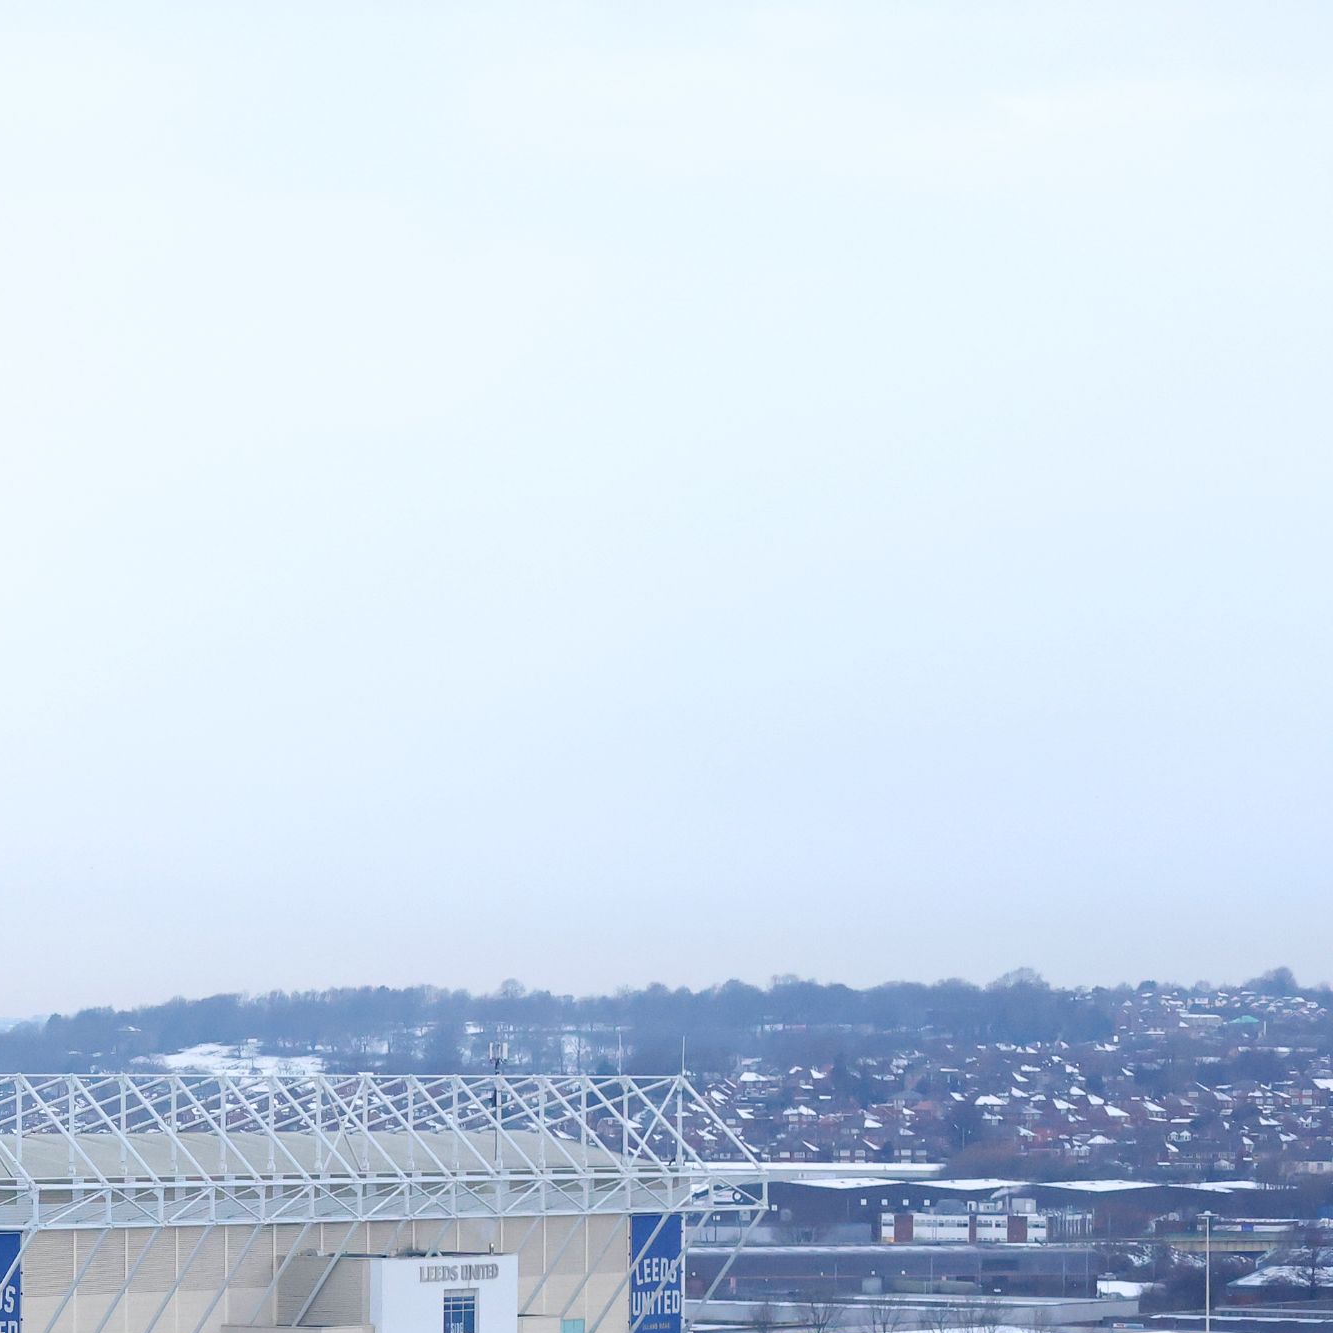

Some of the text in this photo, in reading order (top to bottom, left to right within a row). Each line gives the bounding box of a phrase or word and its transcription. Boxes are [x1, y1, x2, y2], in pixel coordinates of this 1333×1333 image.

[419, 1263, 500, 1283] LEEDS UNITED
[635, 1257, 677, 1286] LEEDS
[632, 1289, 681, 1316] UNITED
